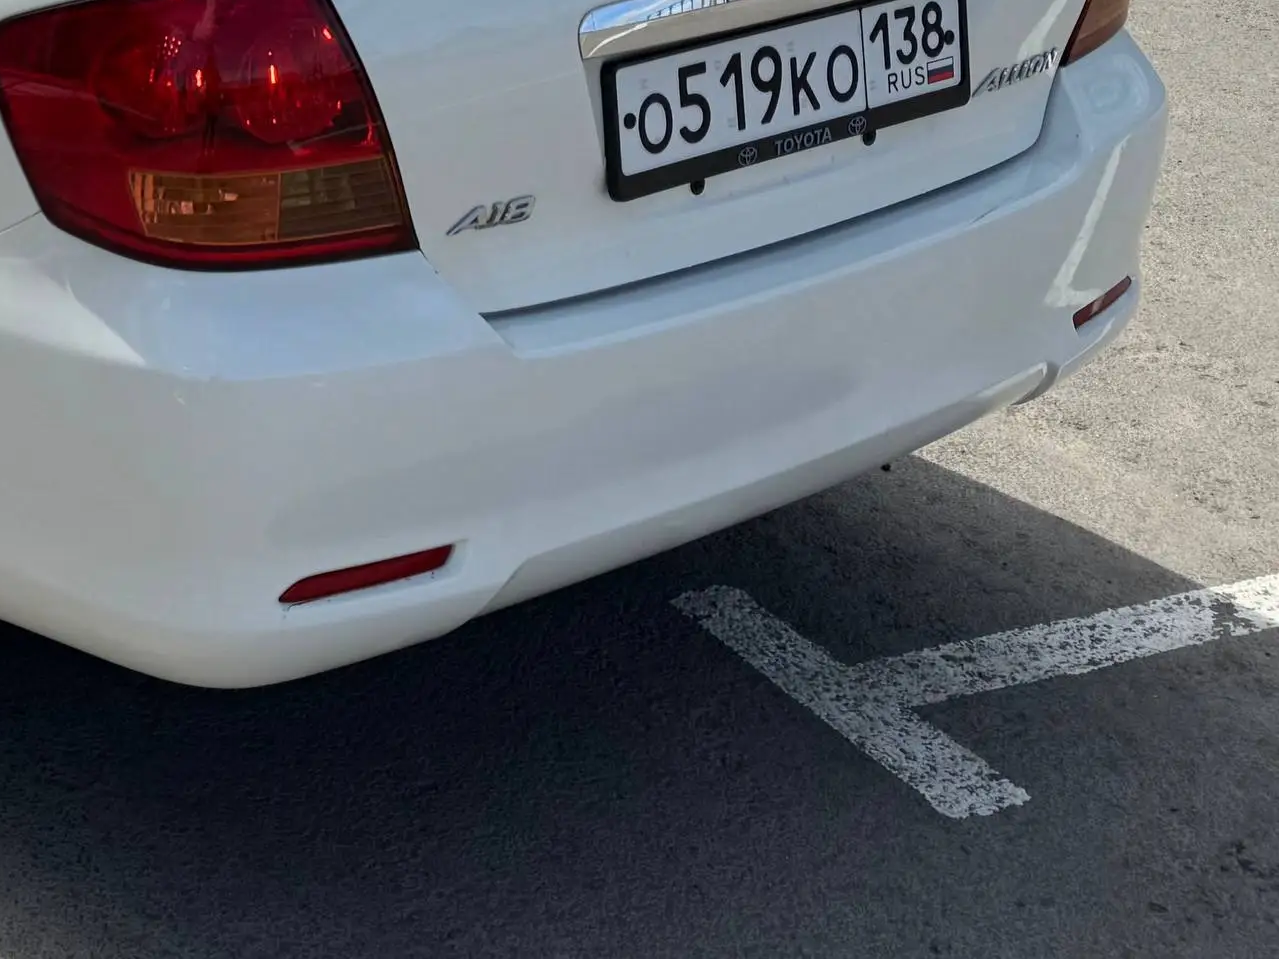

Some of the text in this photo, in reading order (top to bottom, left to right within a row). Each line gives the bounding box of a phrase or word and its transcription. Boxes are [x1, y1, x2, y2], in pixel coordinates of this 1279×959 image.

[869, 1, 945, 71] 138
[887, 65, 926, 94] RUS
[774, 126, 832, 156] TOYOTA
